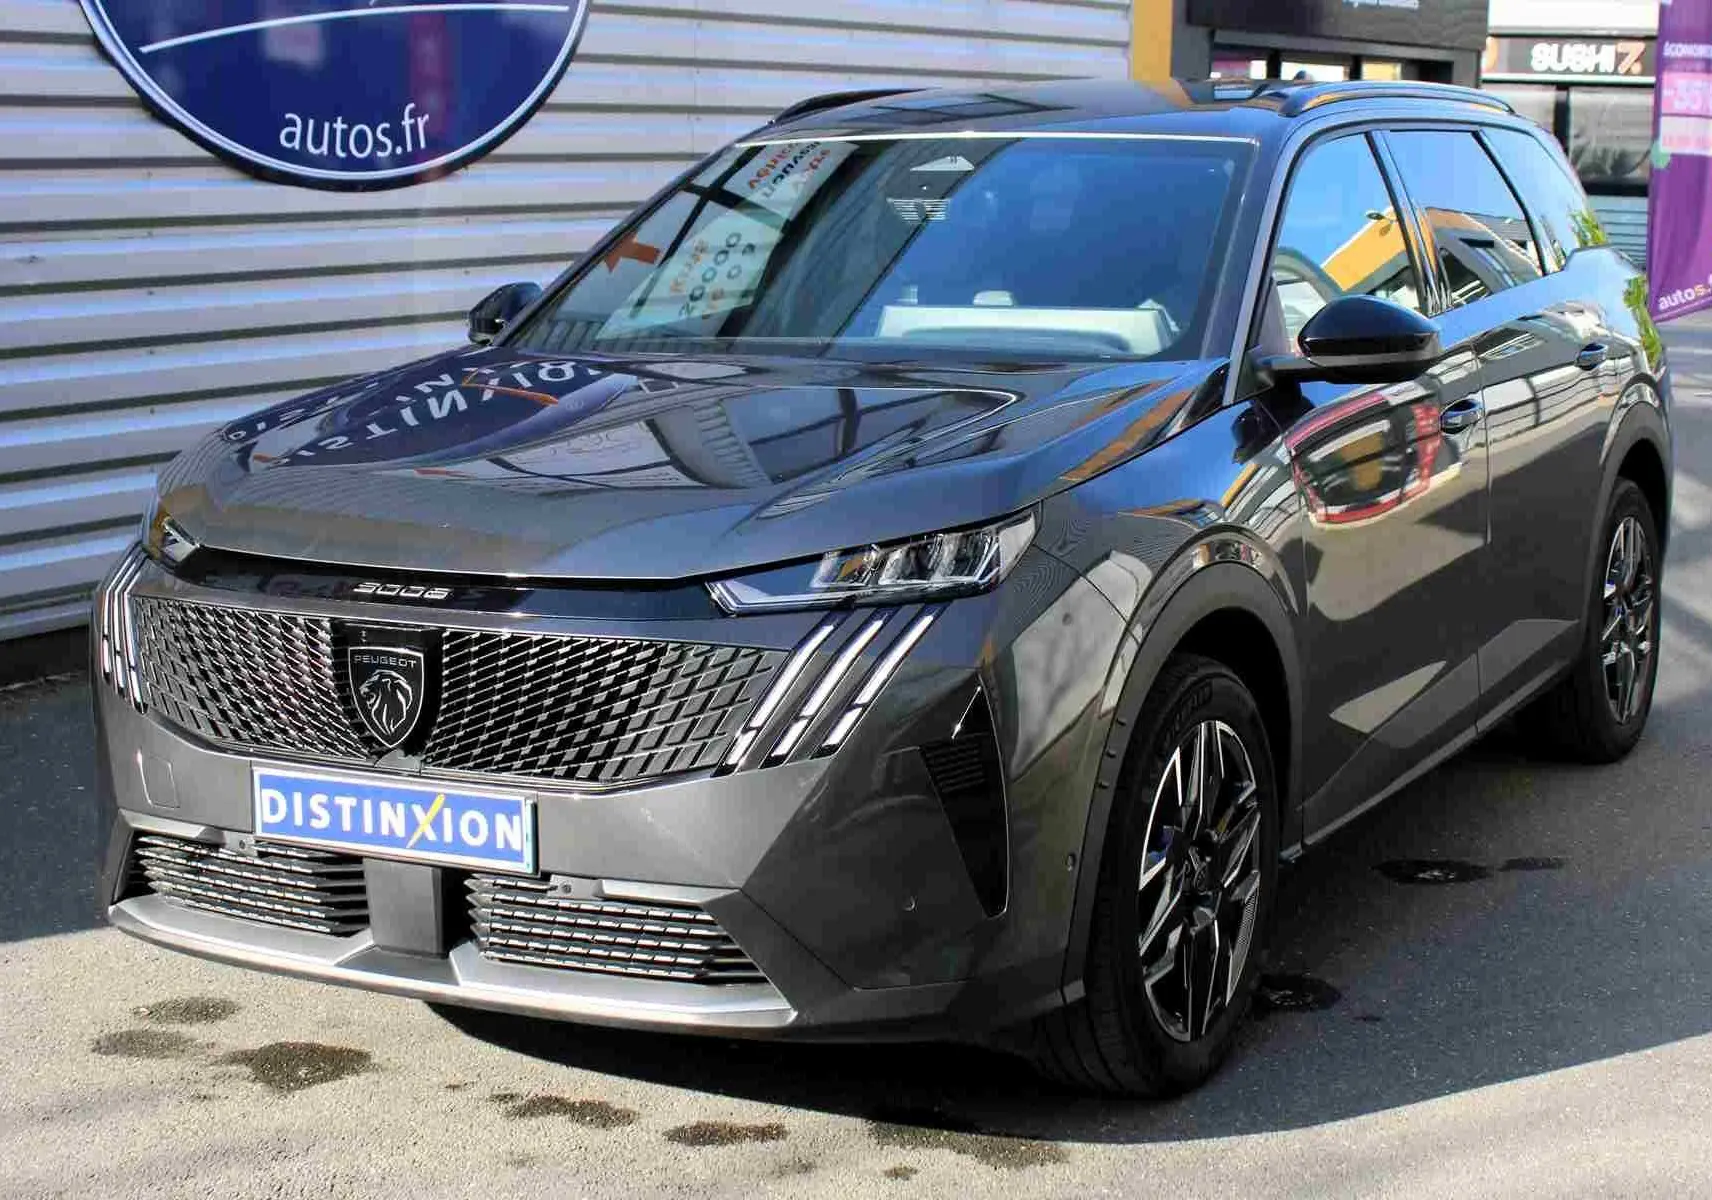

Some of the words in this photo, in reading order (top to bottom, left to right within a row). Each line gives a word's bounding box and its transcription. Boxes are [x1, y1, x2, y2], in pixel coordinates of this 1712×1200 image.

[279, 103, 430, 158] autos.fr
[353, 655, 417, 669] PEUGEOT
[261, 788, 520, 850] DISTINXION
